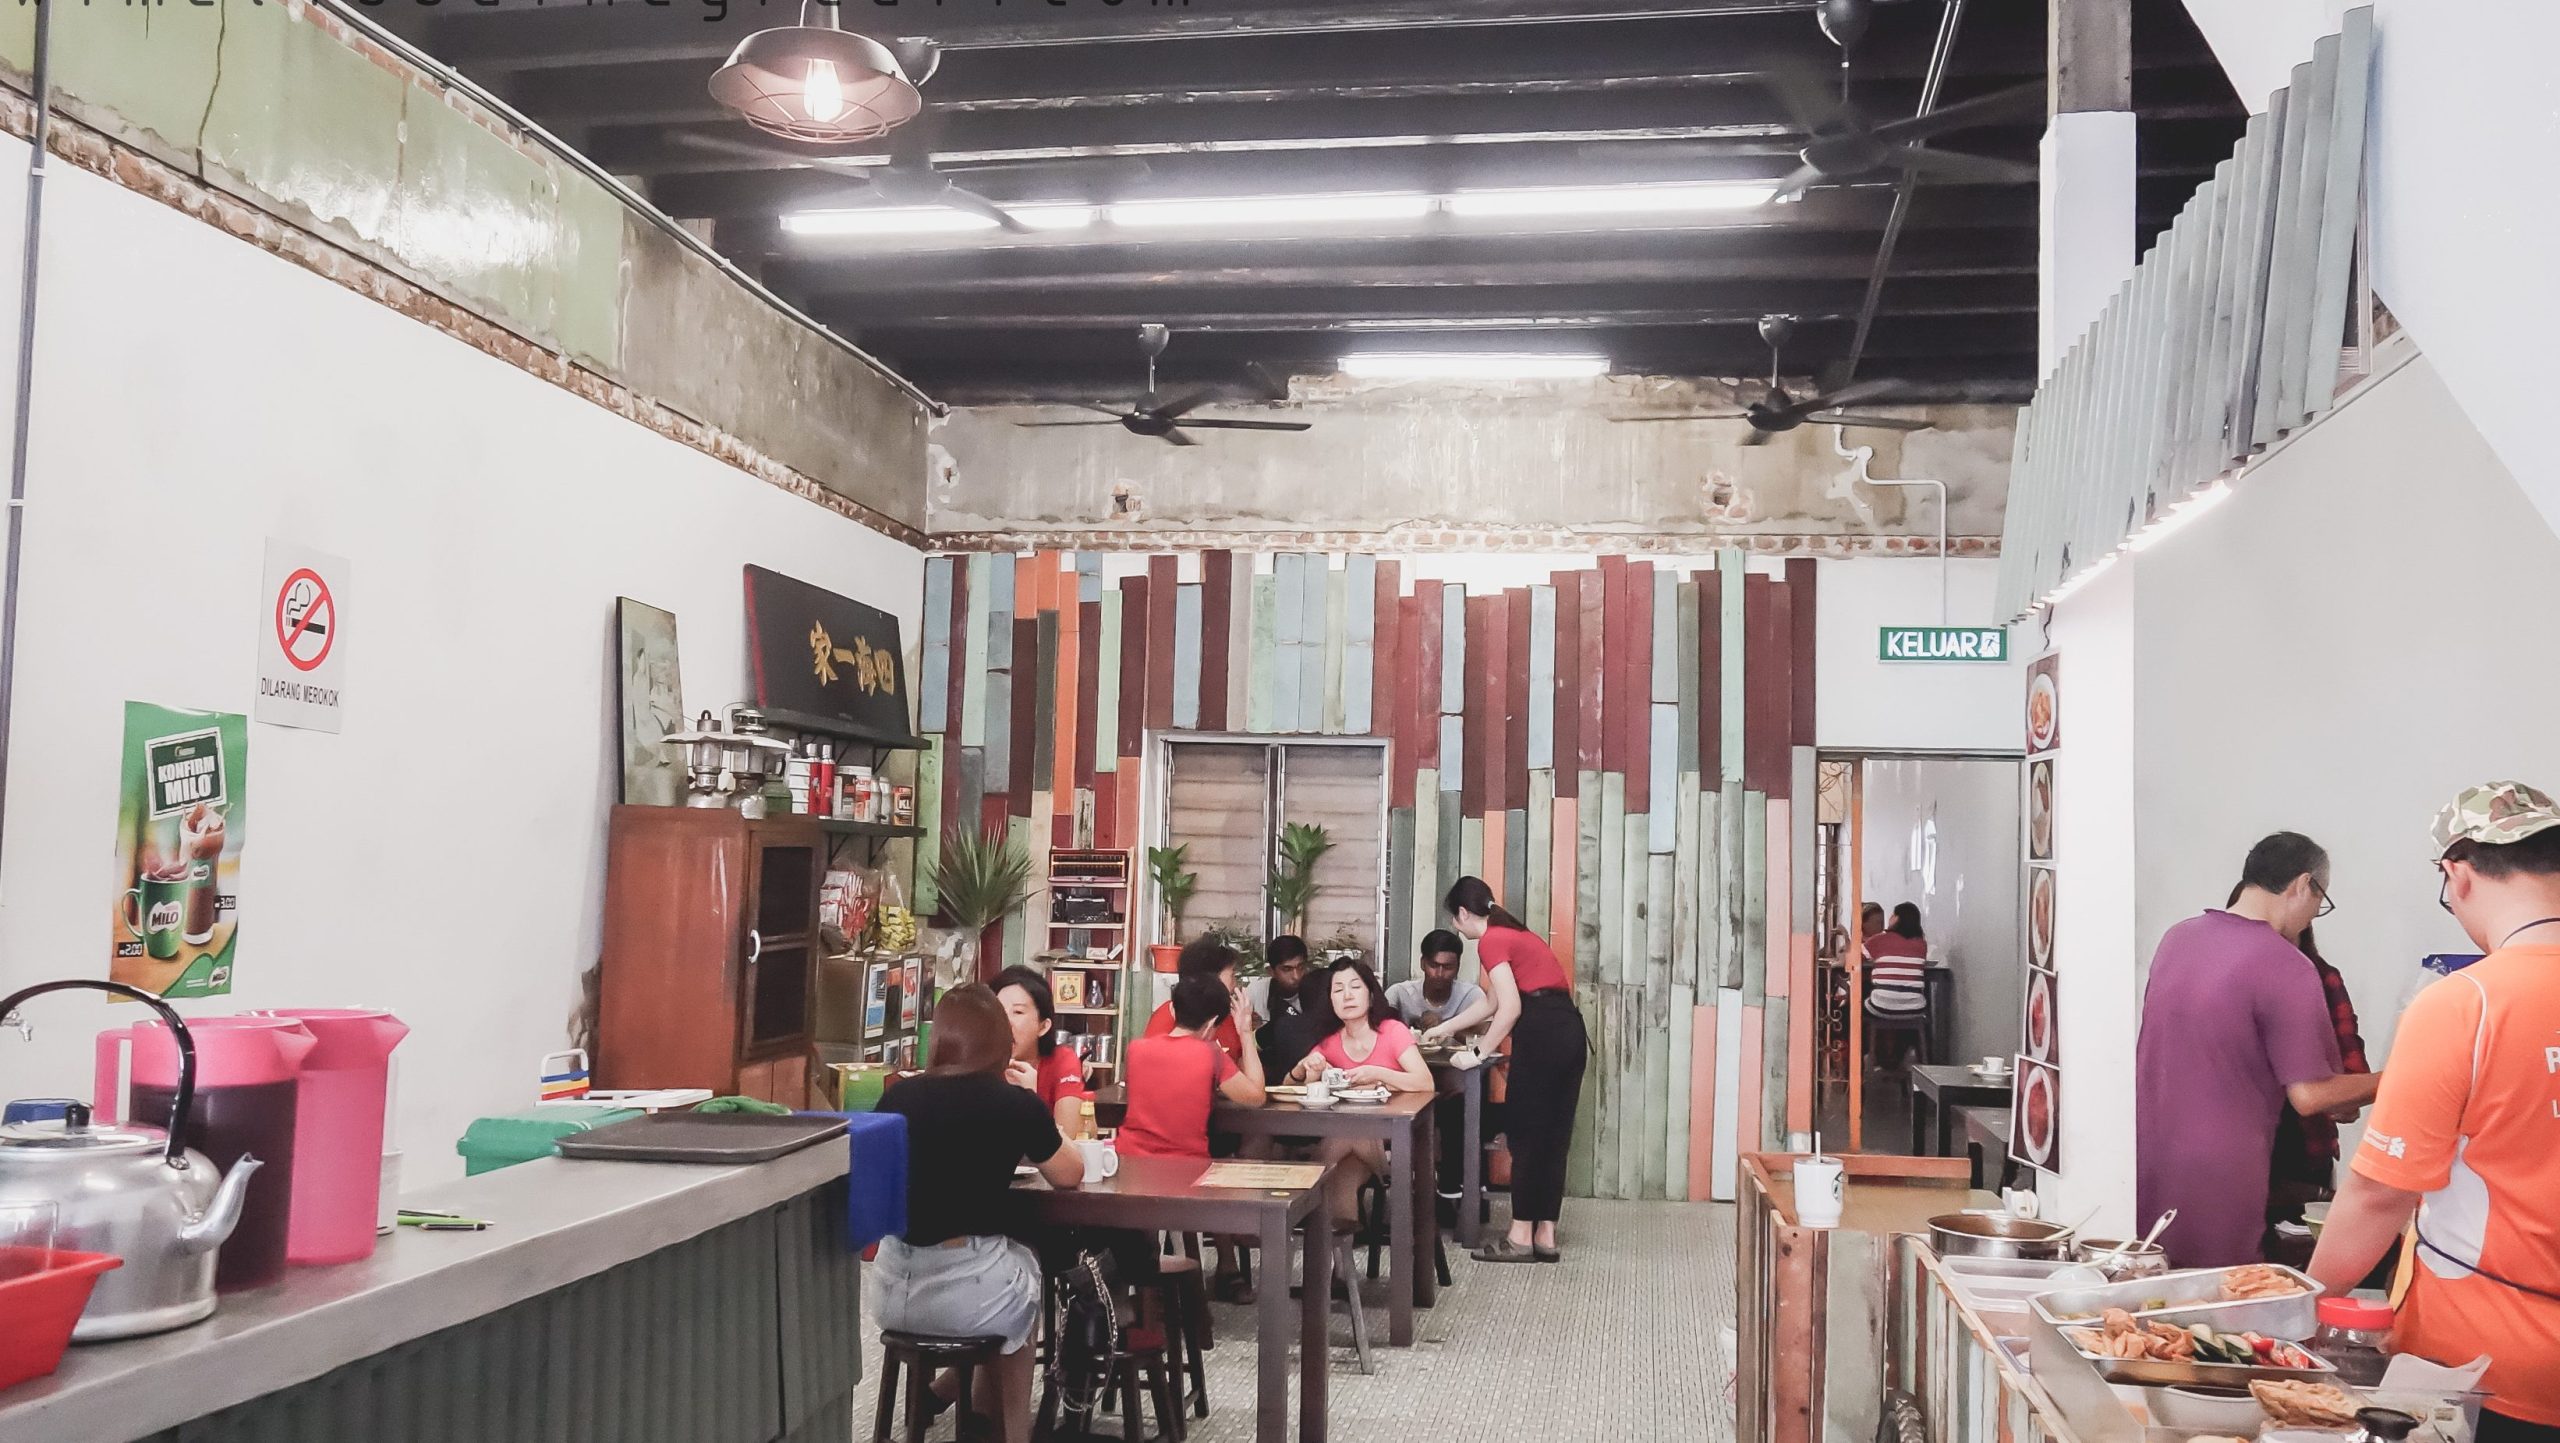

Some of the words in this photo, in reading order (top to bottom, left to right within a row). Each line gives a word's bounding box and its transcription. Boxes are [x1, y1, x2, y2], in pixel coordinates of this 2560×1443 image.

[1887, 631, 1978, 657] KELUAR
[261, 677, 300, 700] DILARANG
[303, 685, 339, 707] MEROKOK
[158, 755, 215, 783] KONFIRM
[165, 774, 211, 805] MILO
[152, 911, 178, 926] MILO
